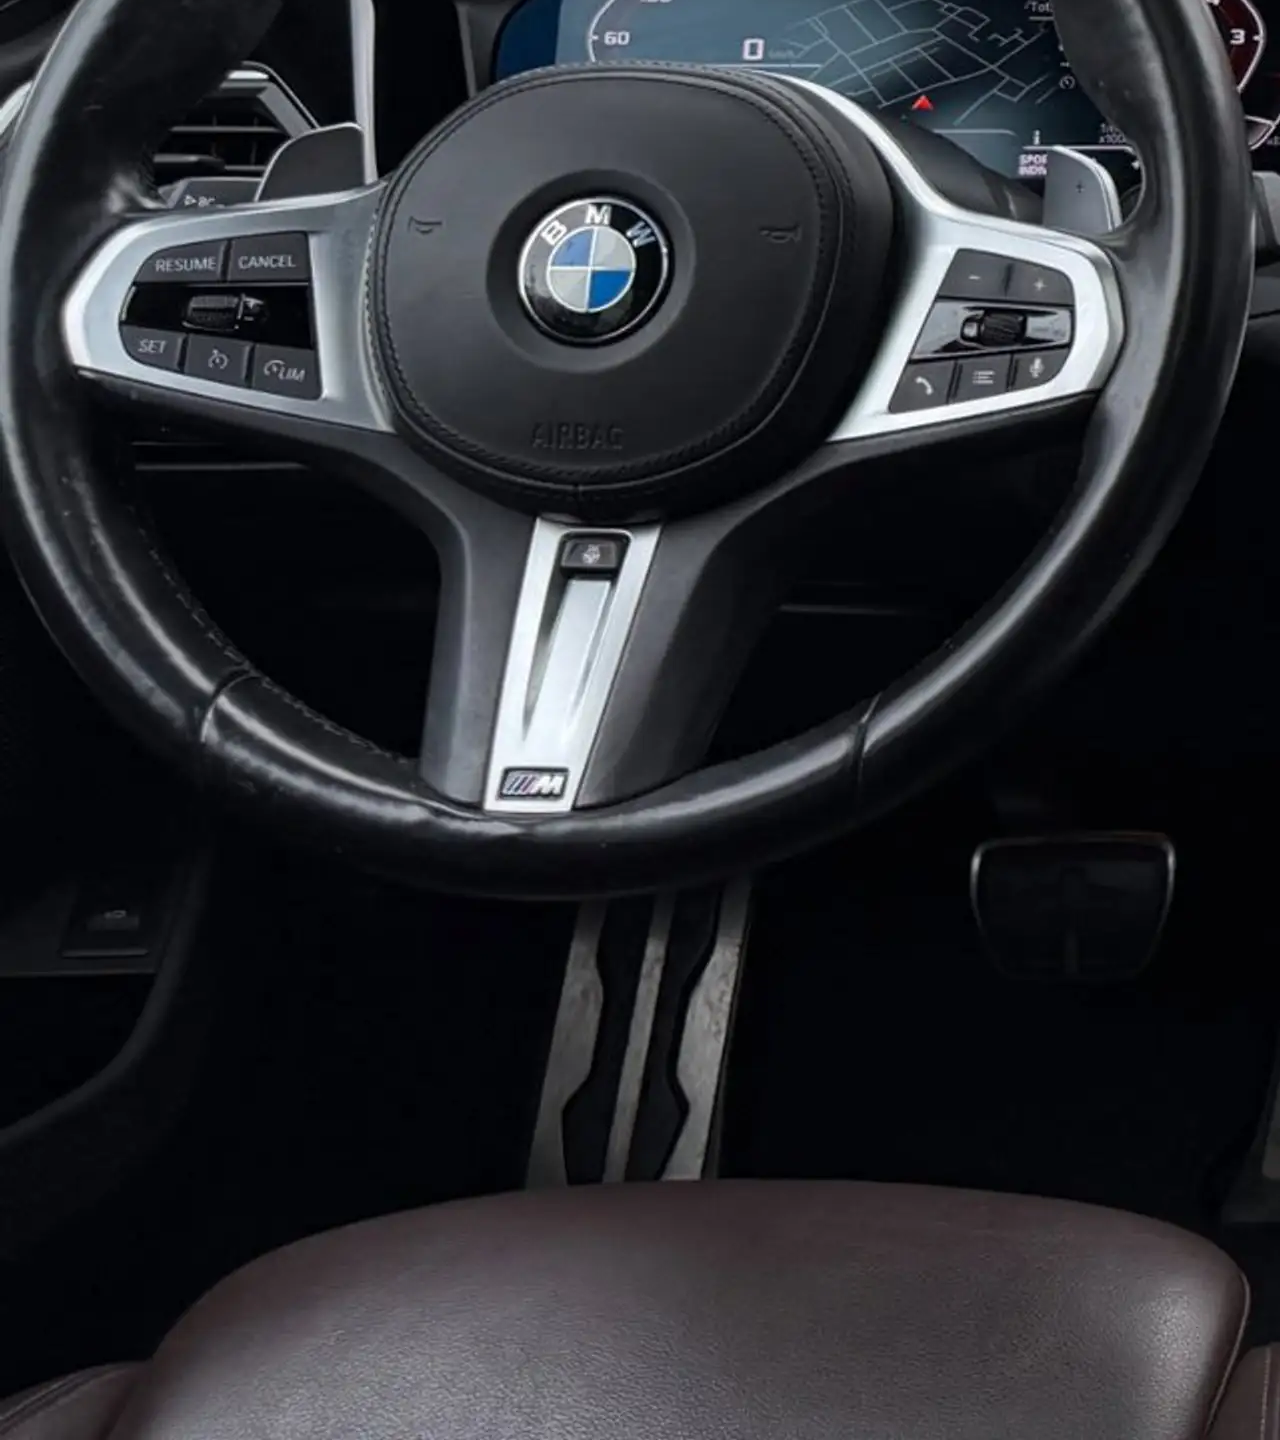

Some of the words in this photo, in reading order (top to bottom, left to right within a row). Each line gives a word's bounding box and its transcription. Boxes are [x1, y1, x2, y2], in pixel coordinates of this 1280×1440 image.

[604, 31, 630, 46] 60
[1230, 29, 1245, 45] 3
[743, 38, 764, 60] 0
[541, 203, 656, 248] BMW
[155, 256, 217, 273] RESUME
[237, 255, 297, 270] CANCEL
[138, 340, 166, 354] SET
[531, 422, 624, 451] AIRBAG
